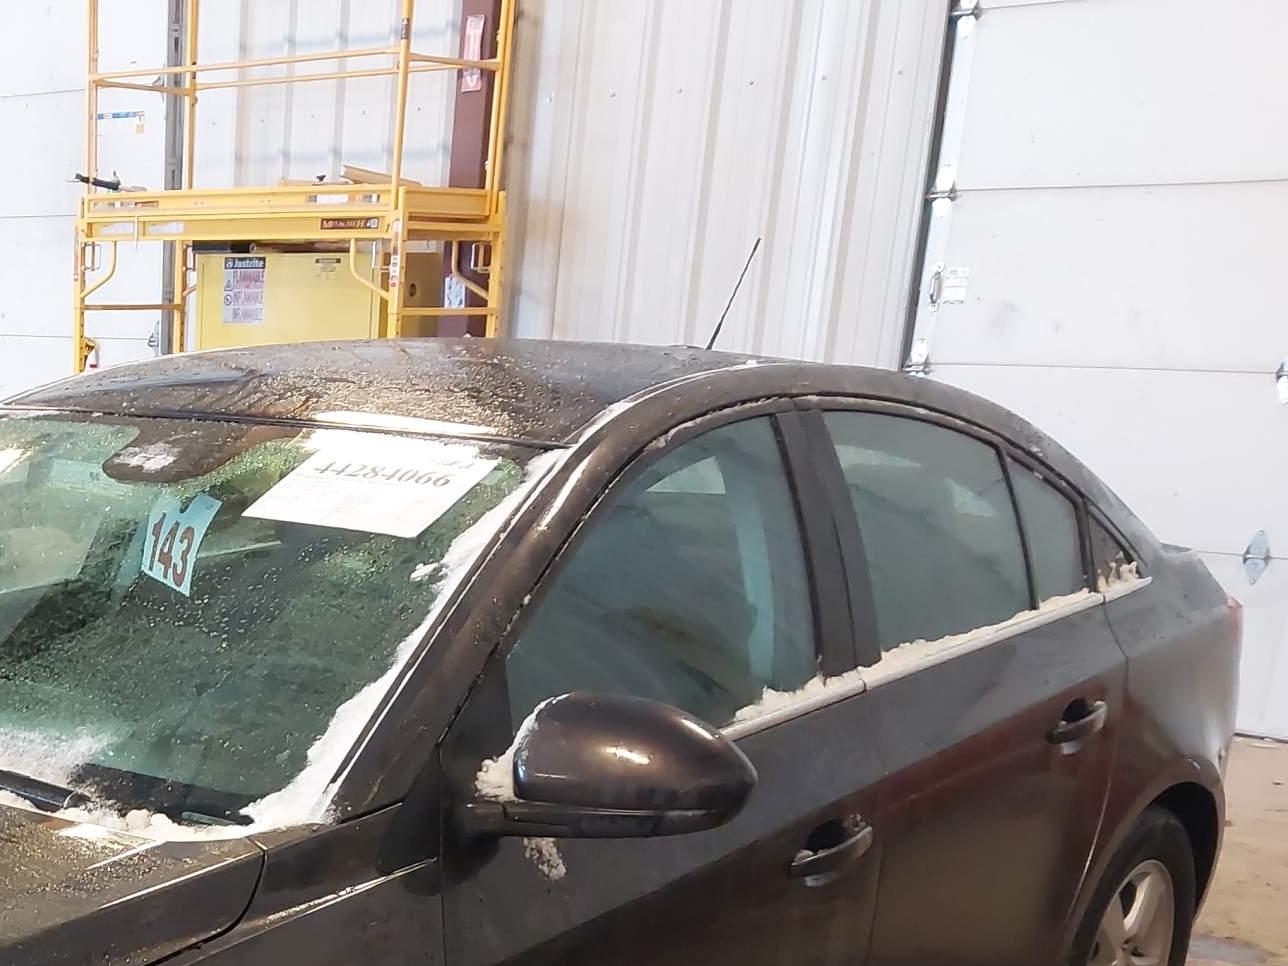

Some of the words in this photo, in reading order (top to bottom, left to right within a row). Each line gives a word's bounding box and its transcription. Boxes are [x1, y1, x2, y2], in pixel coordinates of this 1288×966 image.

[234, 258, 264, 268] Justrite
[314, 460, 451, 488] 44284066
[147, 512, 195, 587] 143
